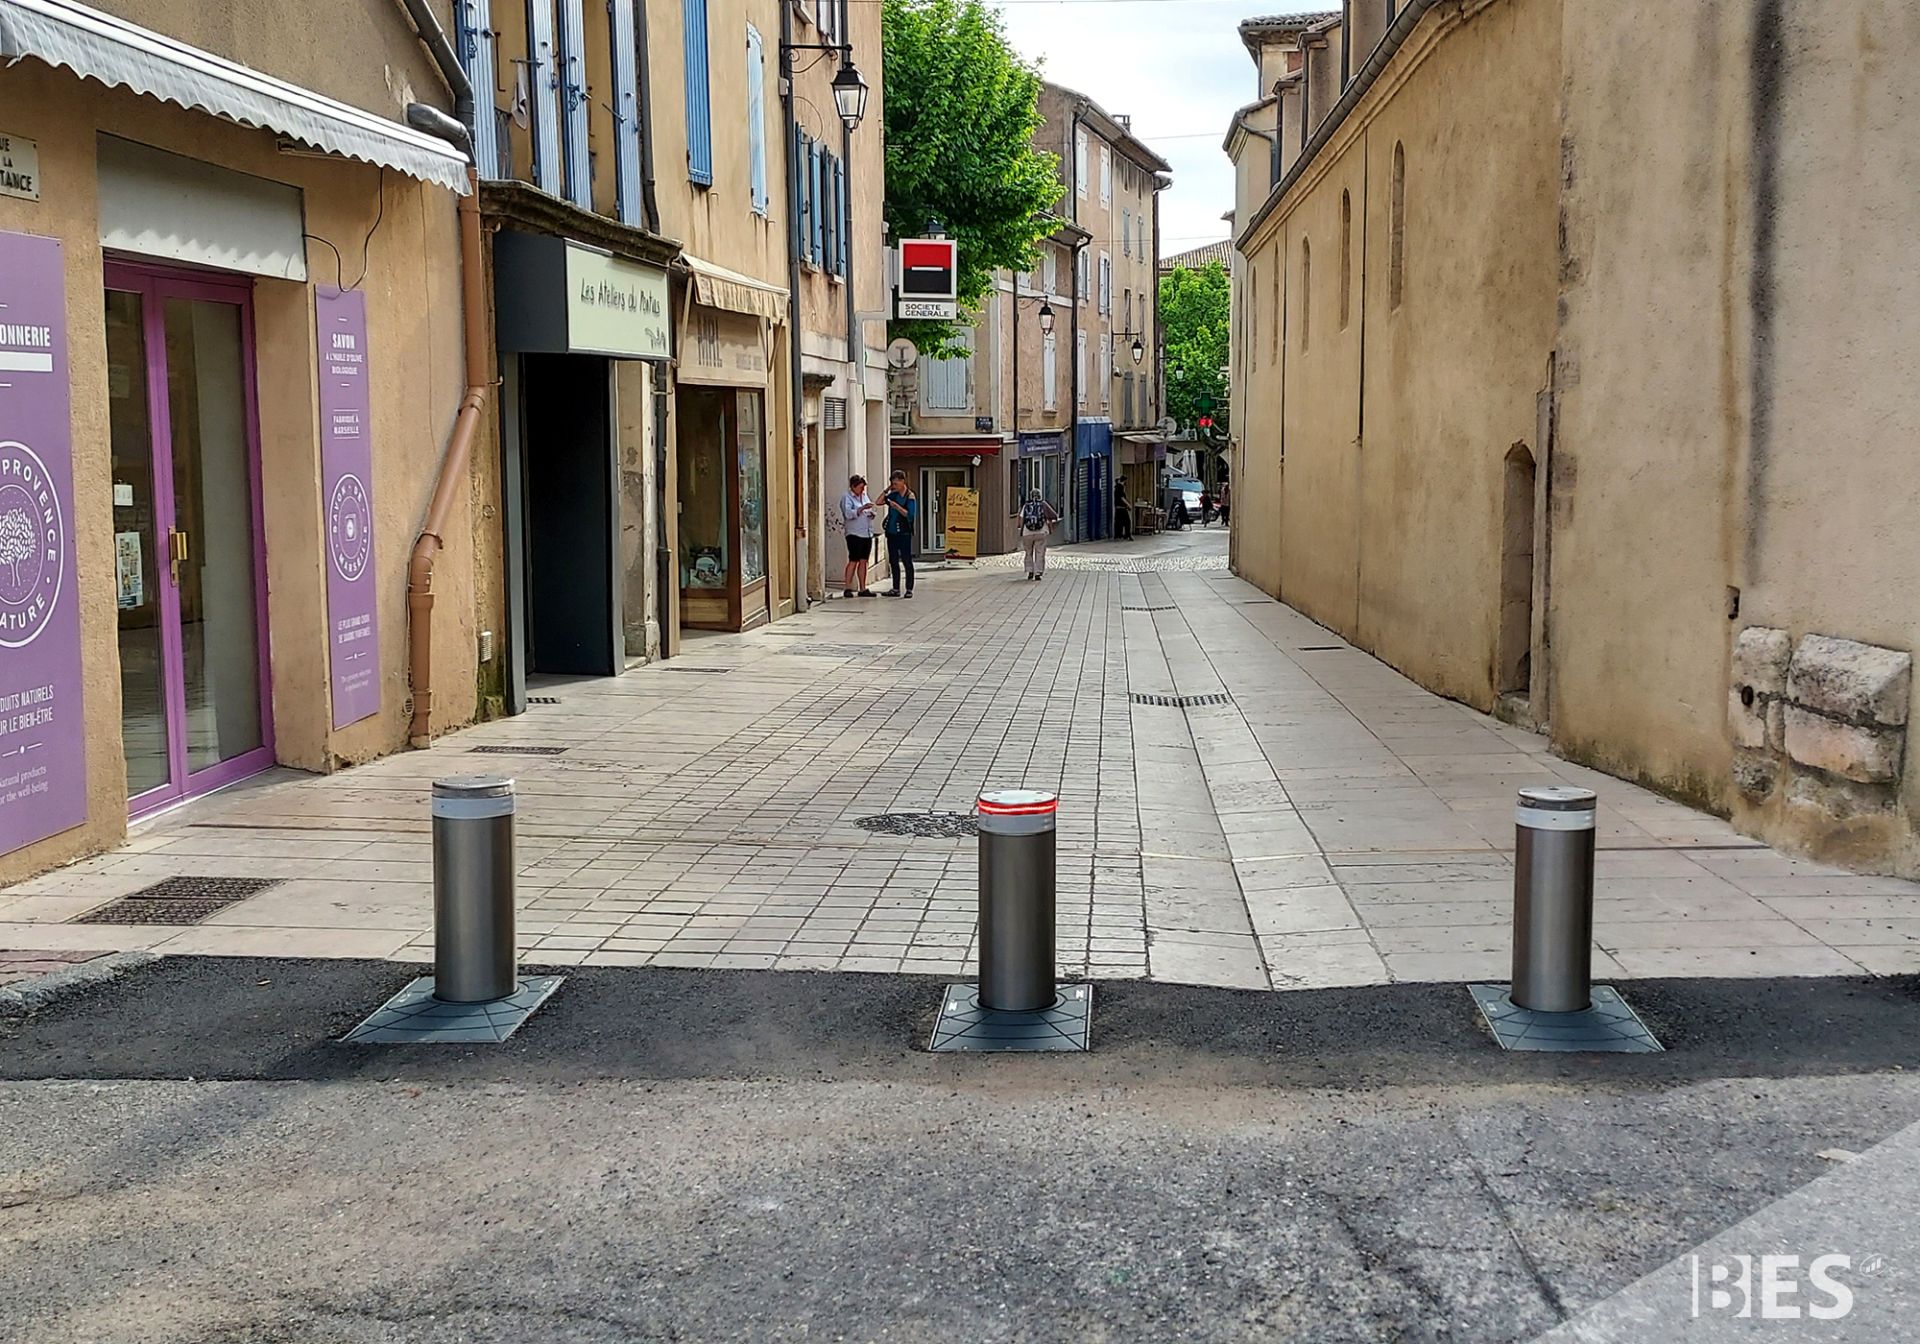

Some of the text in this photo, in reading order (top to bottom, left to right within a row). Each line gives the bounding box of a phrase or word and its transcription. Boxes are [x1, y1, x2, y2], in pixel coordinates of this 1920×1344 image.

[3, 156, 13, 168] LA
[581, 277, 595, 305] Les
[598, 278, 626, 311] Ateliers
[628, 283, 637, 312] du
[905, 303, 942, 311] SOCIETE
[905, 309, 951, 318] GENERALE
[332, 333, 355, 349] SAVON
[2, 459, 56, 561] PROVENCE
[21, 684, 54, 706] NATURELS
[9, 716, 19, 733] LE
[20, 766, 47, 784] products
